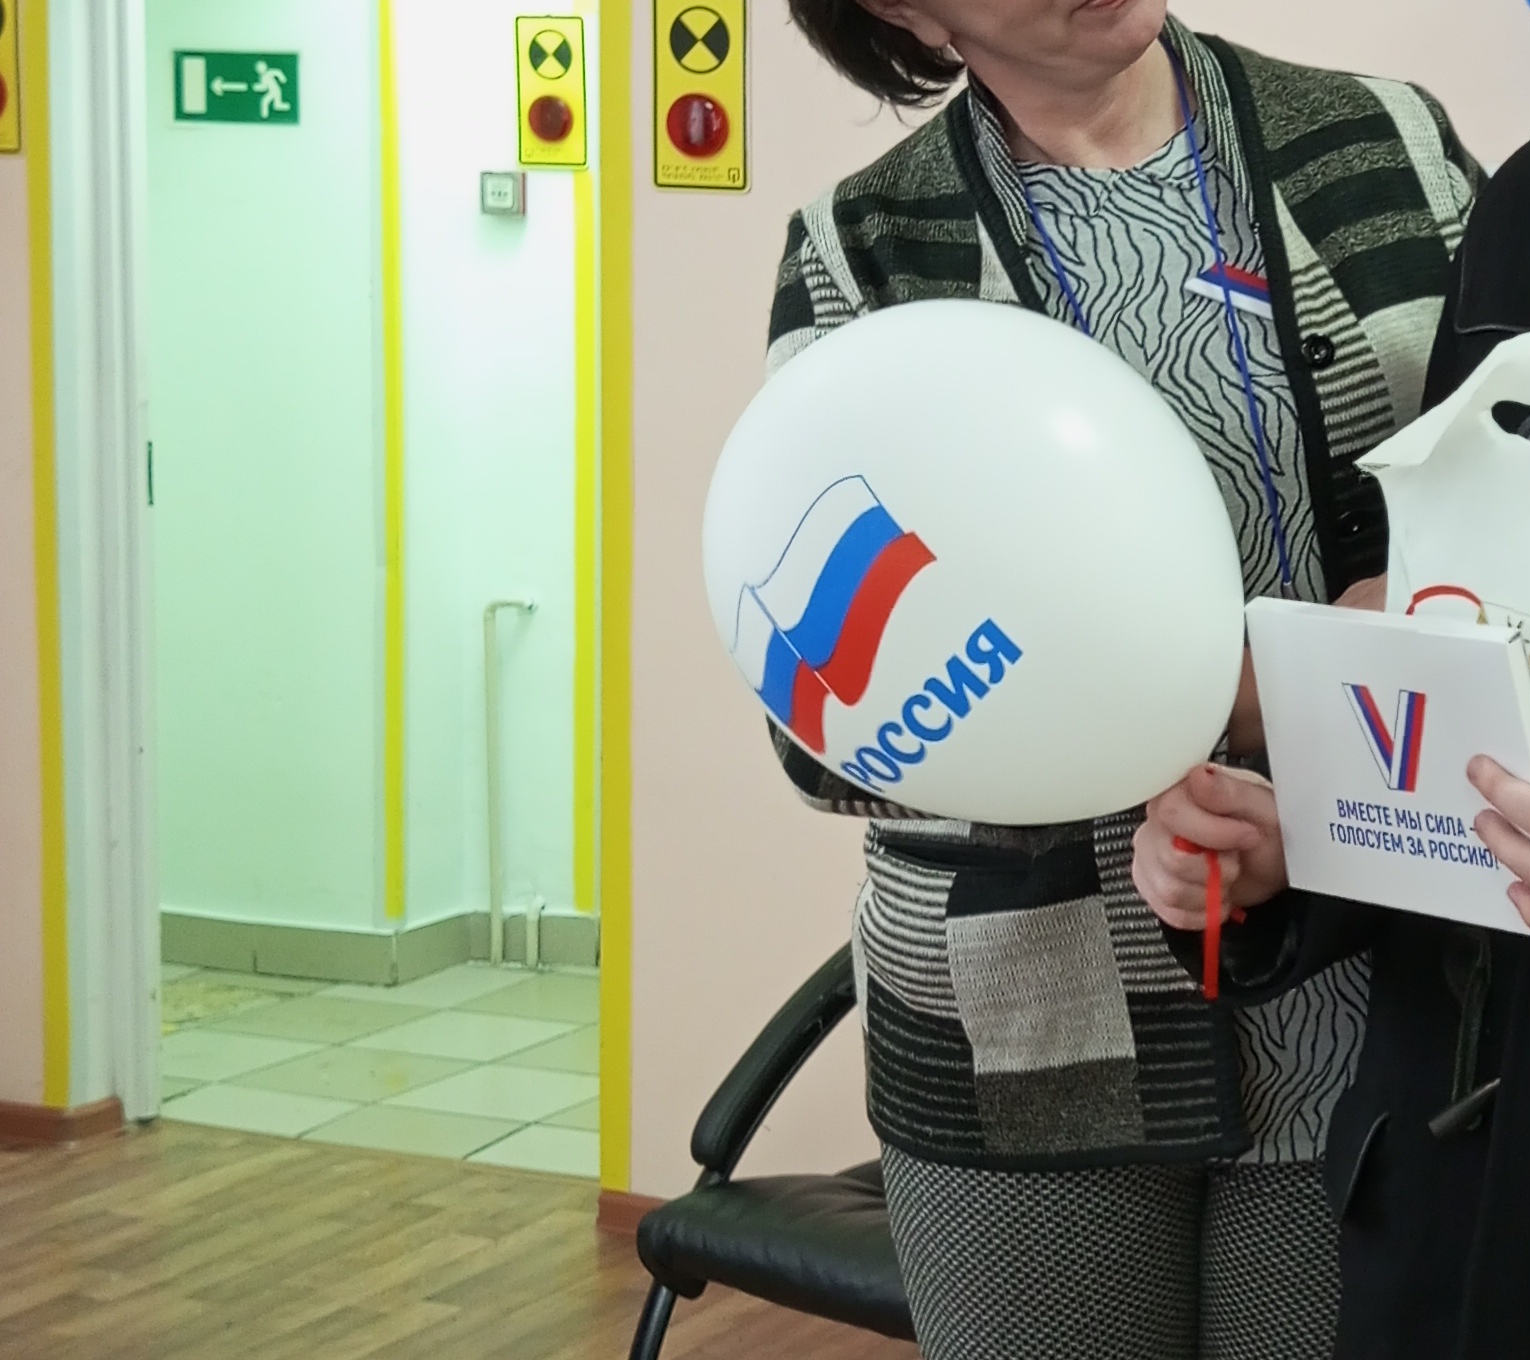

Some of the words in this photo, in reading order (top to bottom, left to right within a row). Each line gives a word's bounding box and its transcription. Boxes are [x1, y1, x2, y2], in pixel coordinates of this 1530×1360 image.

[840, 618, 1023, 793] РОССИЯ
[1336, 798, 1392, 827] ВМЕСТЕ
[1395, 808, 1422, 832] МЫ
[1425, 813, 1467, 838] СИЛА
[1329, 822, 1405, 854] ГОЛОСУЕМ
[1406, 835, 1427, 858] ЗА
